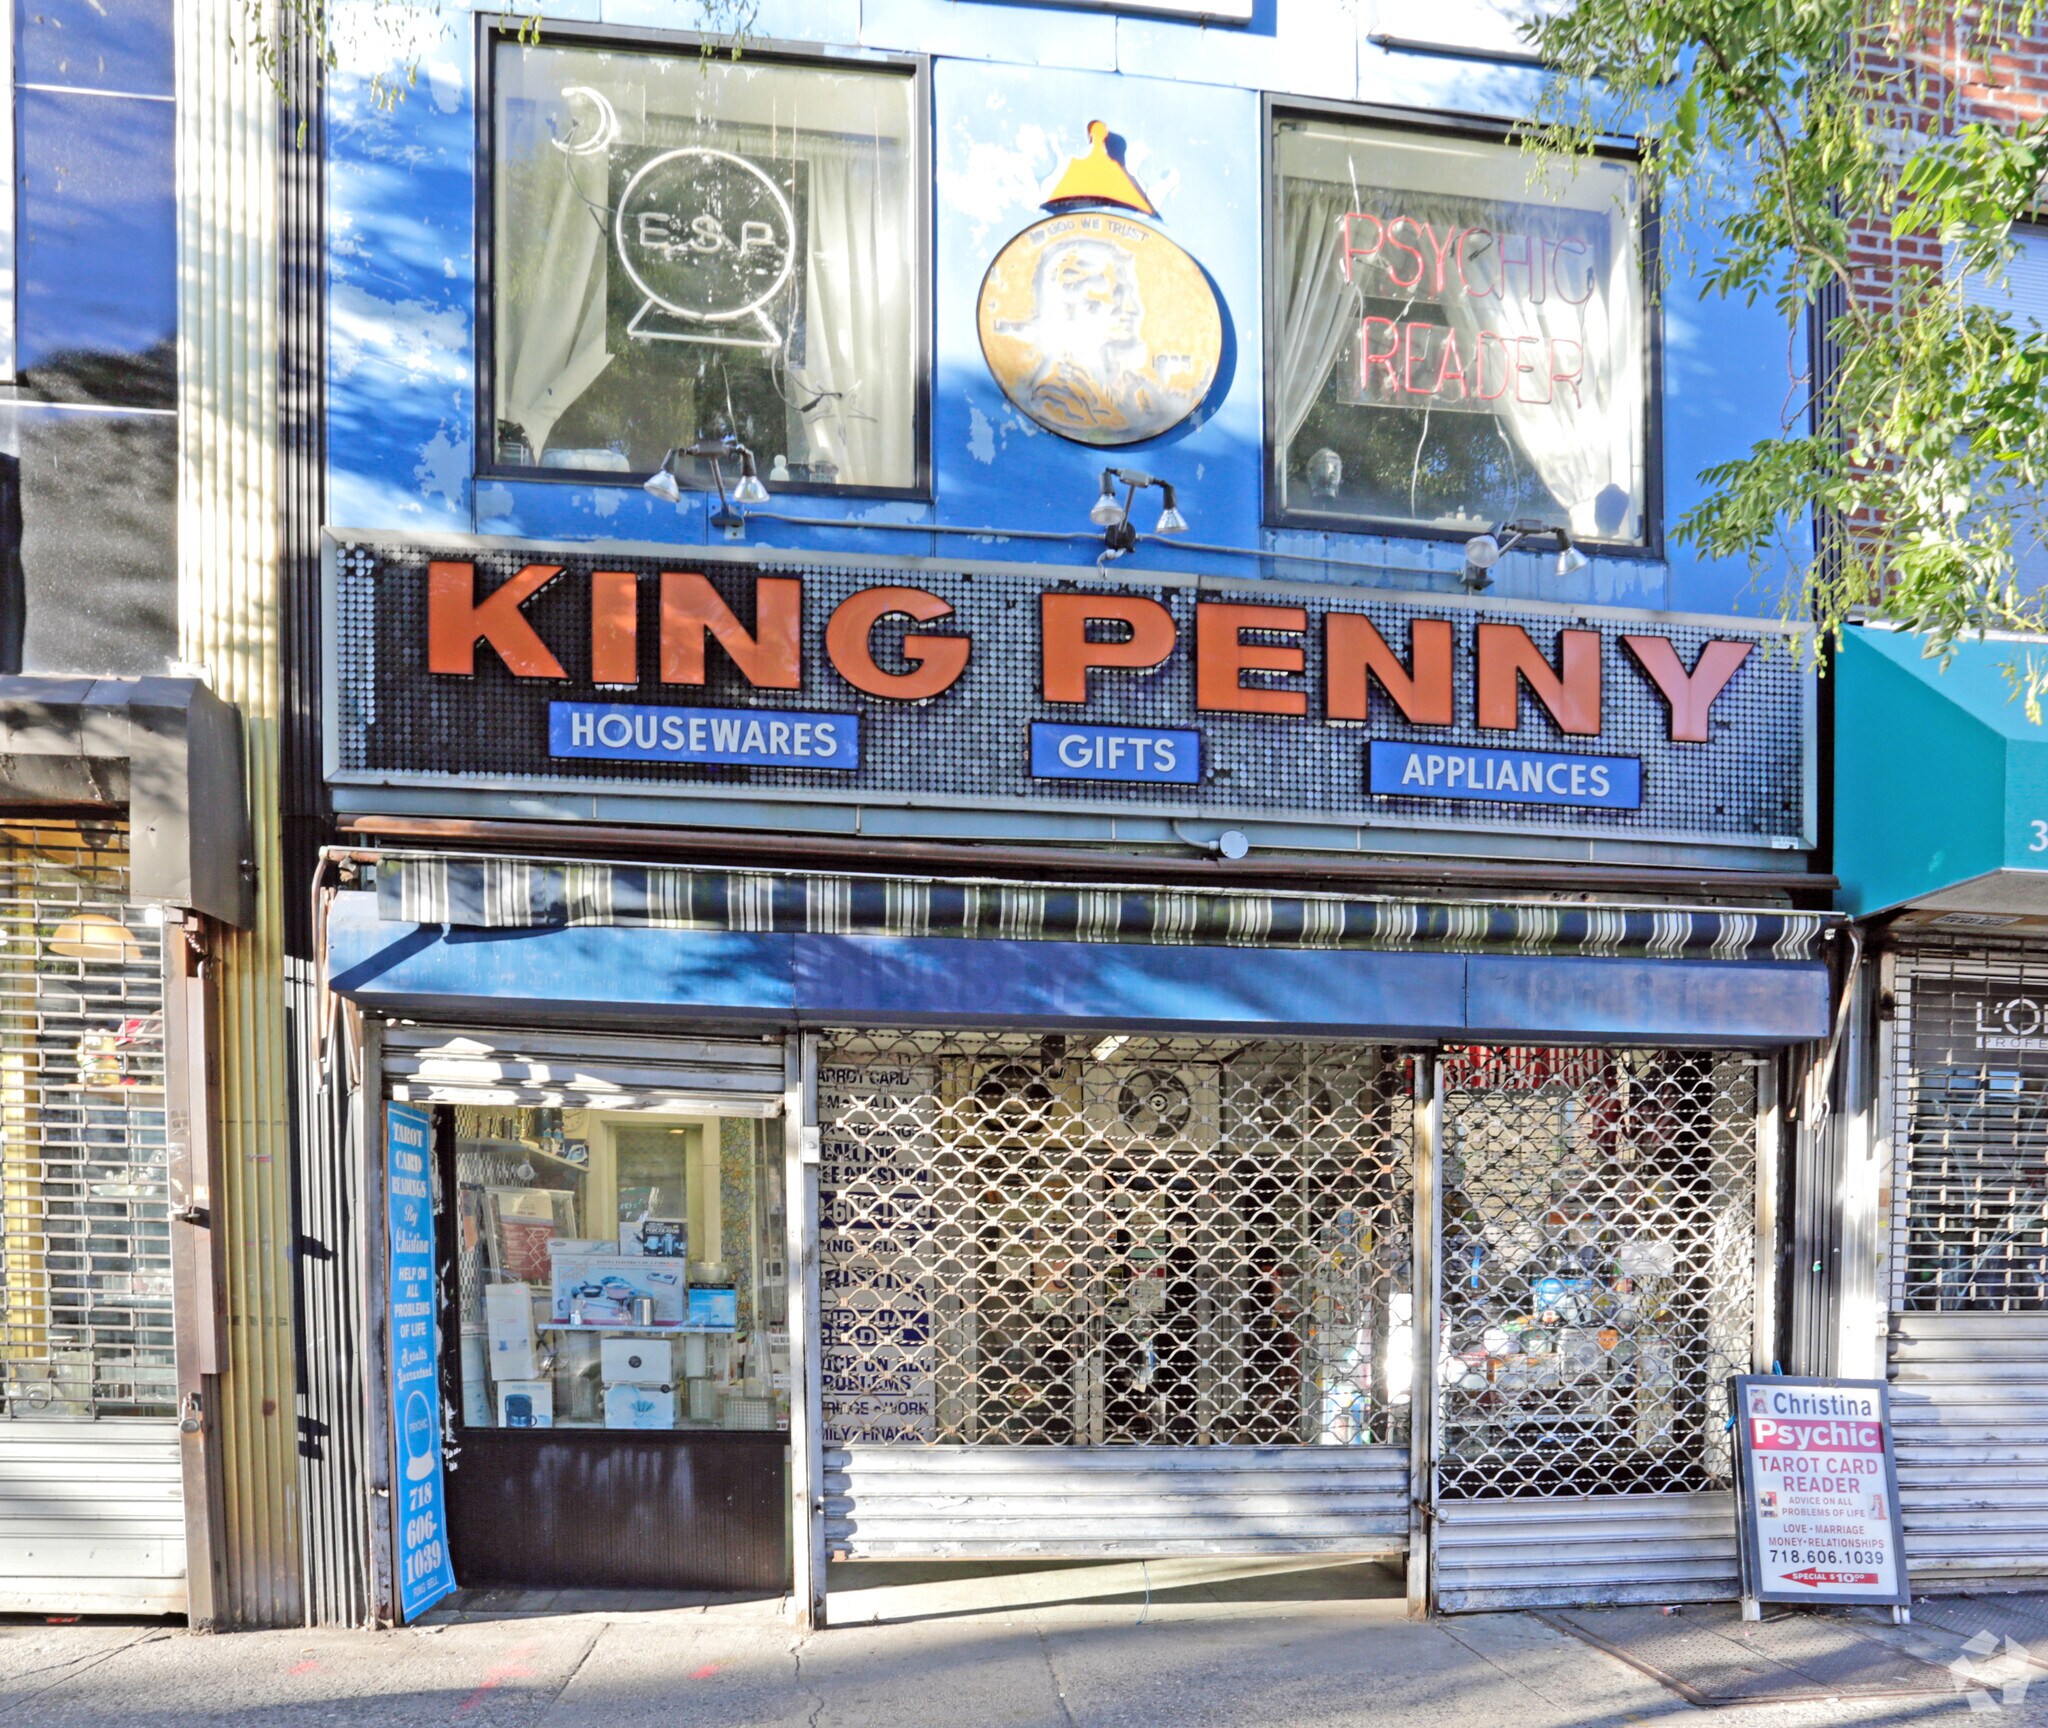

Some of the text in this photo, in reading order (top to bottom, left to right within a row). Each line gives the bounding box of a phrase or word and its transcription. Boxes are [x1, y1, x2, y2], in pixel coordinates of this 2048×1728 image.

[1106, 220, 1150, 242] TRUST
[1344, 212, 1594, 305] PSYCHIC
[1361, 316, 1583, 409] READER
[427, 560, 1755, 744] KING PENNY
[571, 714, 839, 759] HOUSEWARES
[1058, 734, 1178, 774] GIFTS
[1401, 753, 1611, 799] APPLIANCES
[870, 1070, 910, 1086] CARD
[392, 1122, 424, 1148] TAROT
[395, 1150, 422, 1173] CARD
[821, 1143, 860, 1161] CALL
[392, 1176, 427, 1199] READINGS
[404, 1203, 419, 1227] By
[395, 1227, 429, 1254] Christina
[399, 1267, 427, 1281] HELP ON
[406, 1283, 419, 1298] ALL
[394, 1302, 431, 1319] PROBLEMS
[400, 1321, 427, 1338] OF LIFE
[401, 1346, 427, 1368] Results
[396, 1362, 433, 1390] Guaranteed
[1773, 1391, 1872, 1417] Christina
[863, 1427, 925, 1441] FINANCE
[1755, 1419, 1878, 1451] Psychic
[1758, 1456, 1879, 1475] TAROT CARD
[1782, 1476, 1861, 1494] READER
[409, 1481, 433, 1512] 718
[1789, 1496, 1853, 1506] ADVICE ON ALL
[1782, 1508, 1865, 1518] PROBLEMS OF LIFE
[406, 1510, 438, 1550] 606-
[1783, 1524, 1865, 1535] LOVE MARRIAGE
[405, 1540, 442, 1586] 1039
[1769, 1550, 1884, 1565] 718.606.1039
[413, 1576, 439, 1598] RING BELL
[1792, 1572, 1827, 1581] SPECIAL
